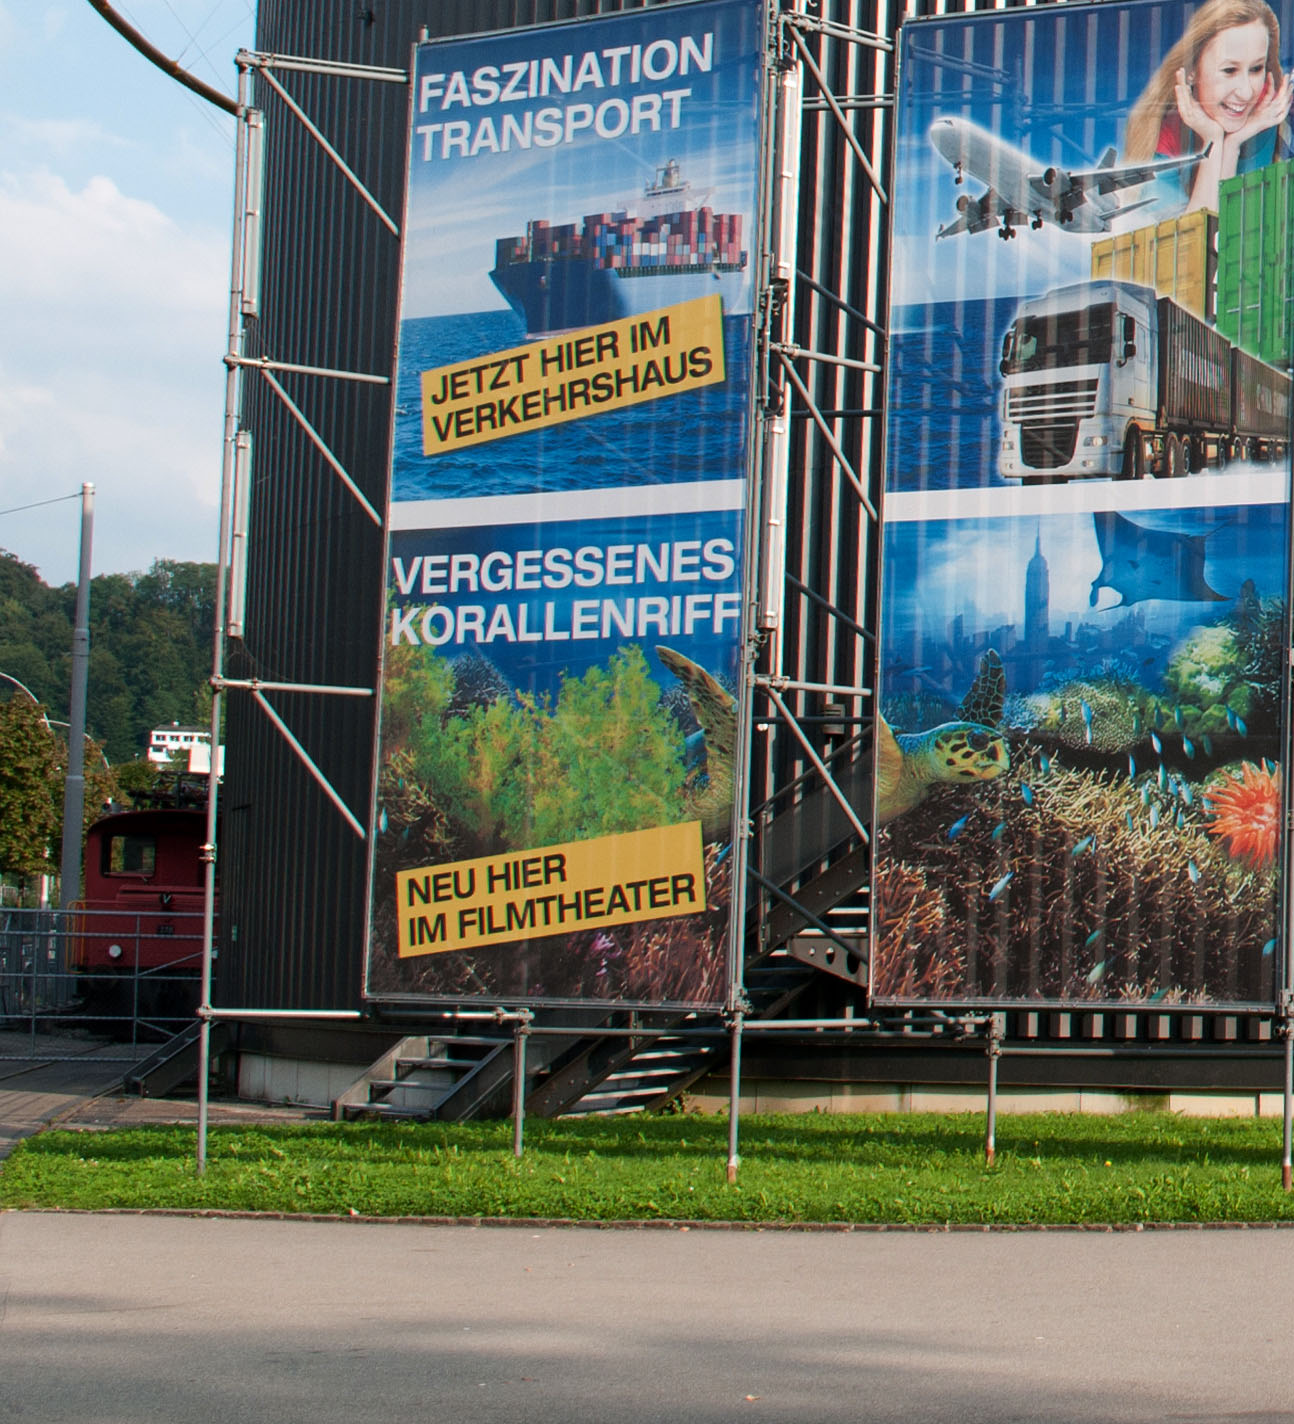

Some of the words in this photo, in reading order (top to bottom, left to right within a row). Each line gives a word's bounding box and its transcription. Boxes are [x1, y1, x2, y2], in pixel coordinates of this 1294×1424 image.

[419, 32, 714, 113] FASZINATION
[416, 88, 692, 162] TRANSPORT
[431, 354, 530, 406] JETZT
[540, 329, 620, 377] HIER
[630, 316, 671, 352] IM
[431, 346, 713, 442] VERKEHRSHAUS
[392, 537, 736, 596] VERGESSENES
[390, 592, 743, 647] KORALLENRIFF
[406, 866, 477, 907] NEU
[486, 852, 568, 895] HIER
[408, 912, 447, 947] IM
[457, 872, 697, 939] FILMTHEATER
